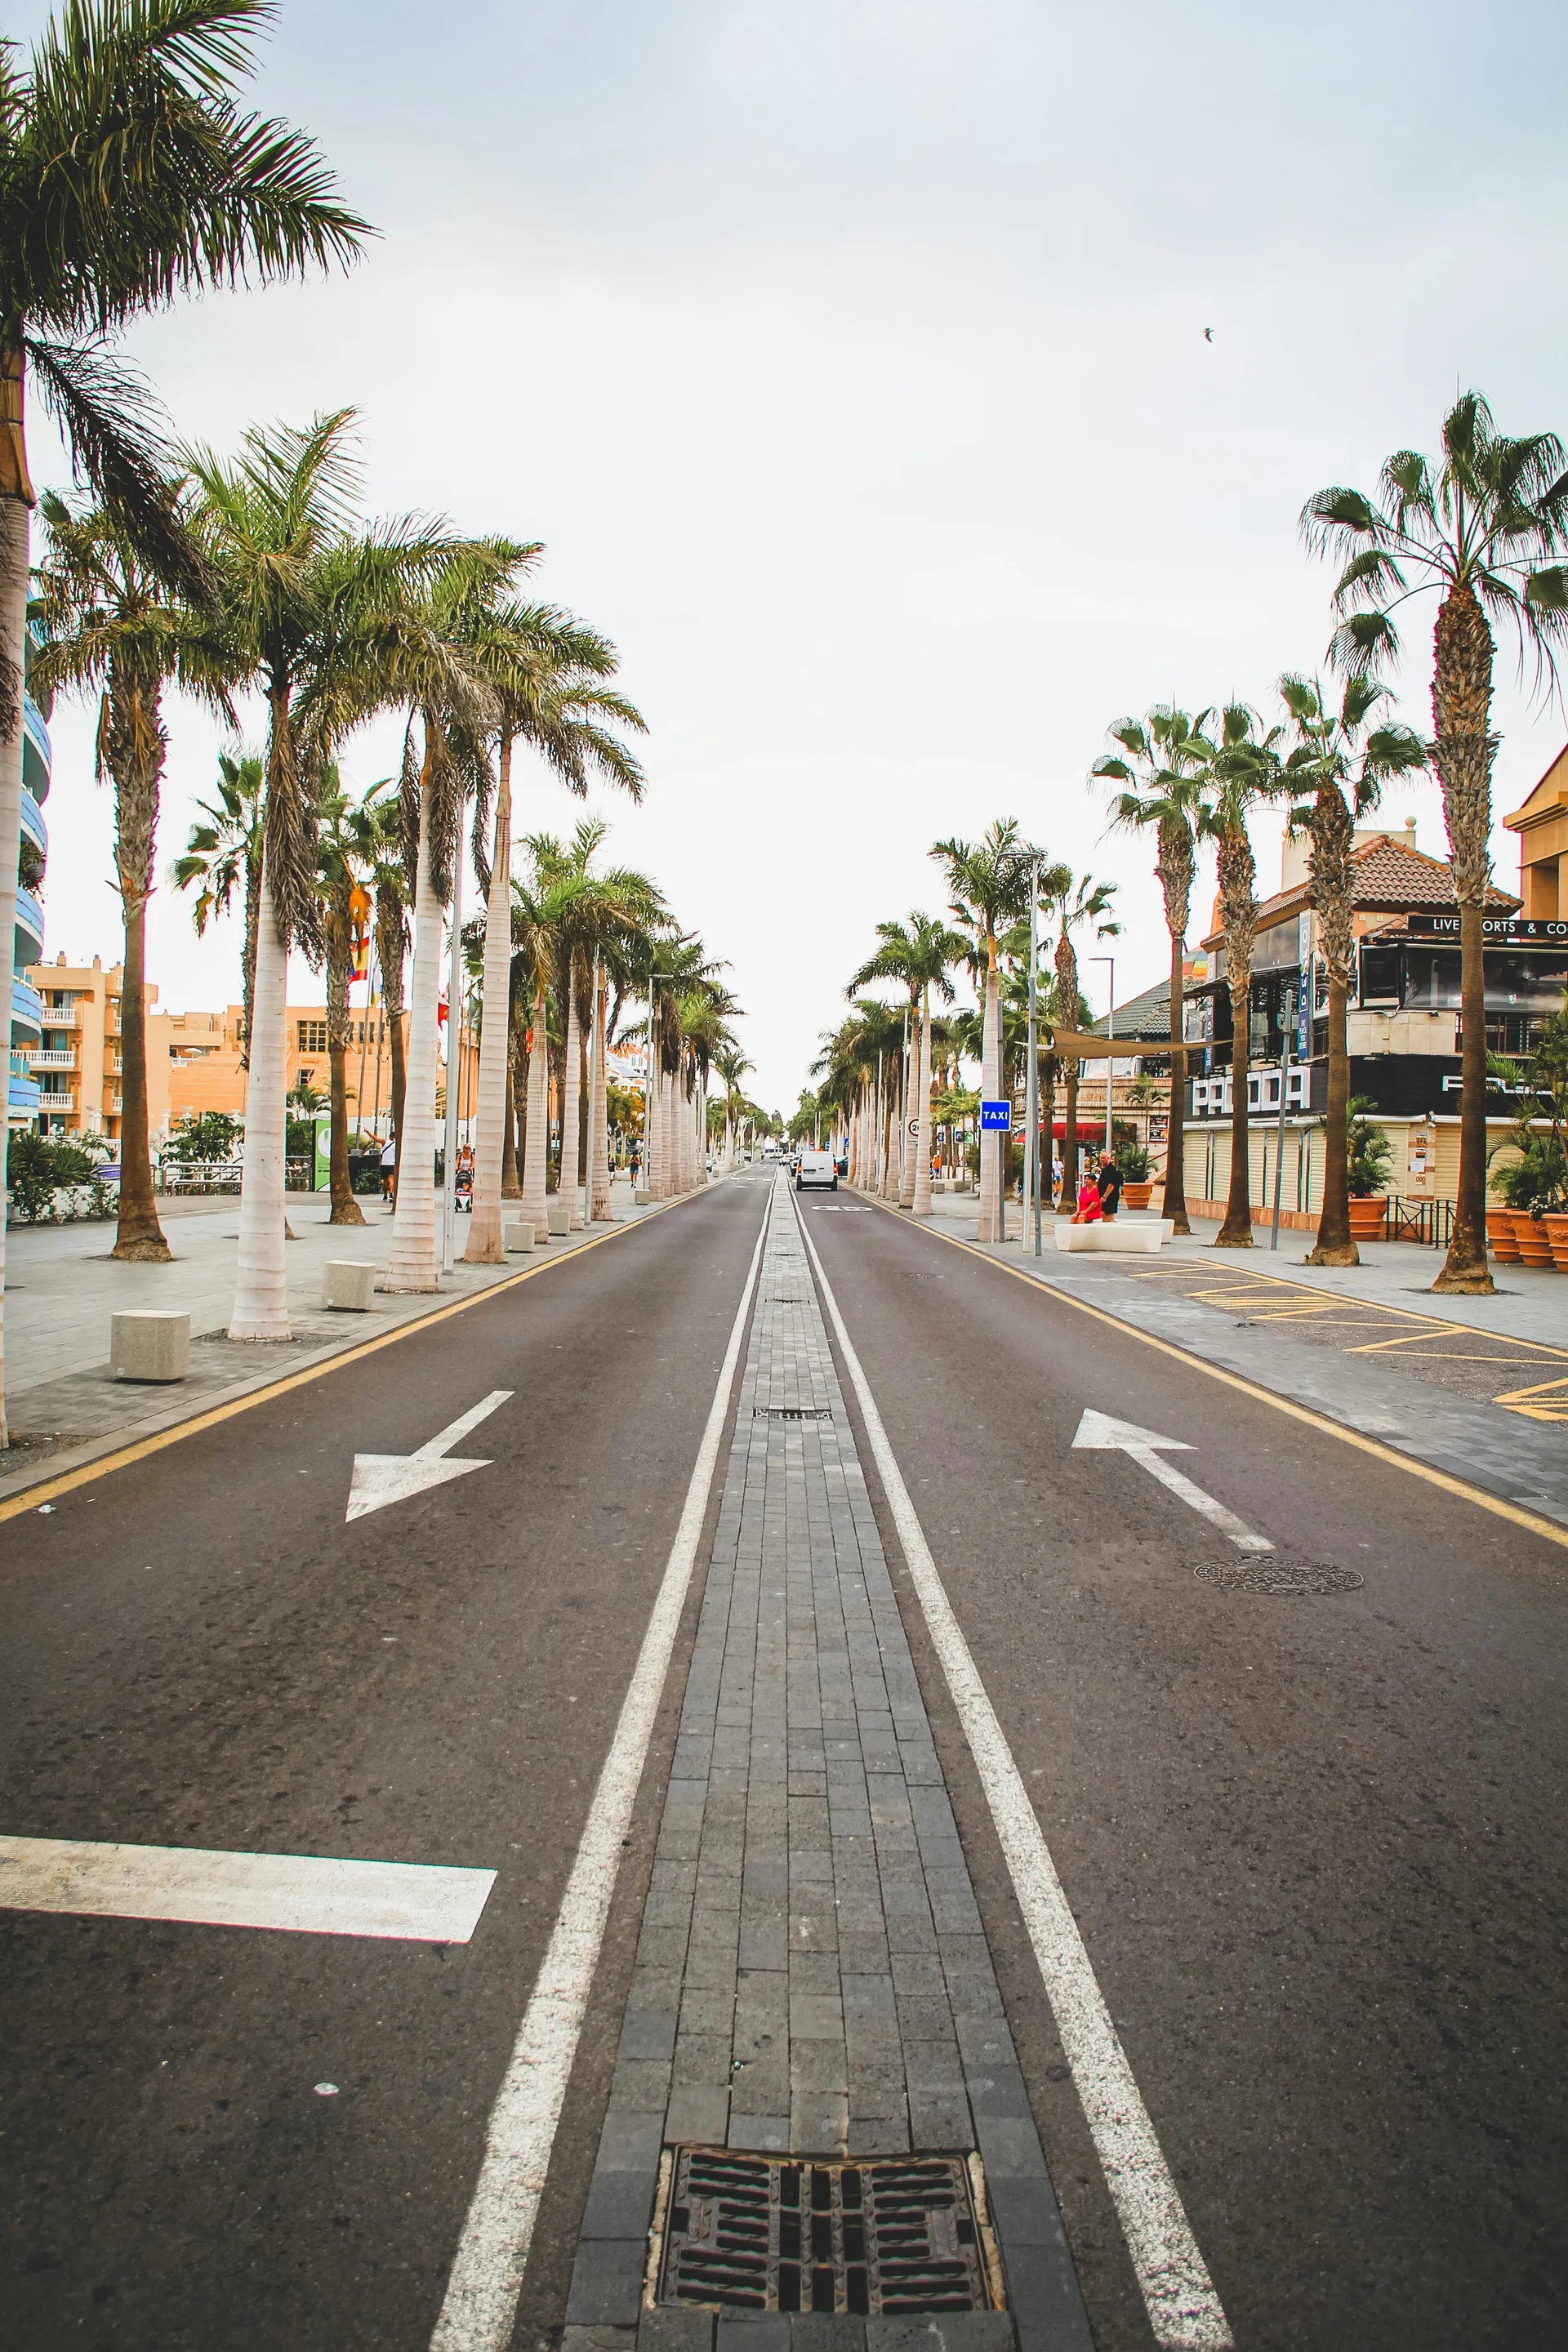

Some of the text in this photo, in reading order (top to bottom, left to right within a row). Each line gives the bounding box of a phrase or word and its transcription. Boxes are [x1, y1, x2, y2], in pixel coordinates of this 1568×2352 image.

[1433, 919, 1568, 935] LIVE ORTS & CO
[982, 1111, 1008, 1120] TAXI
